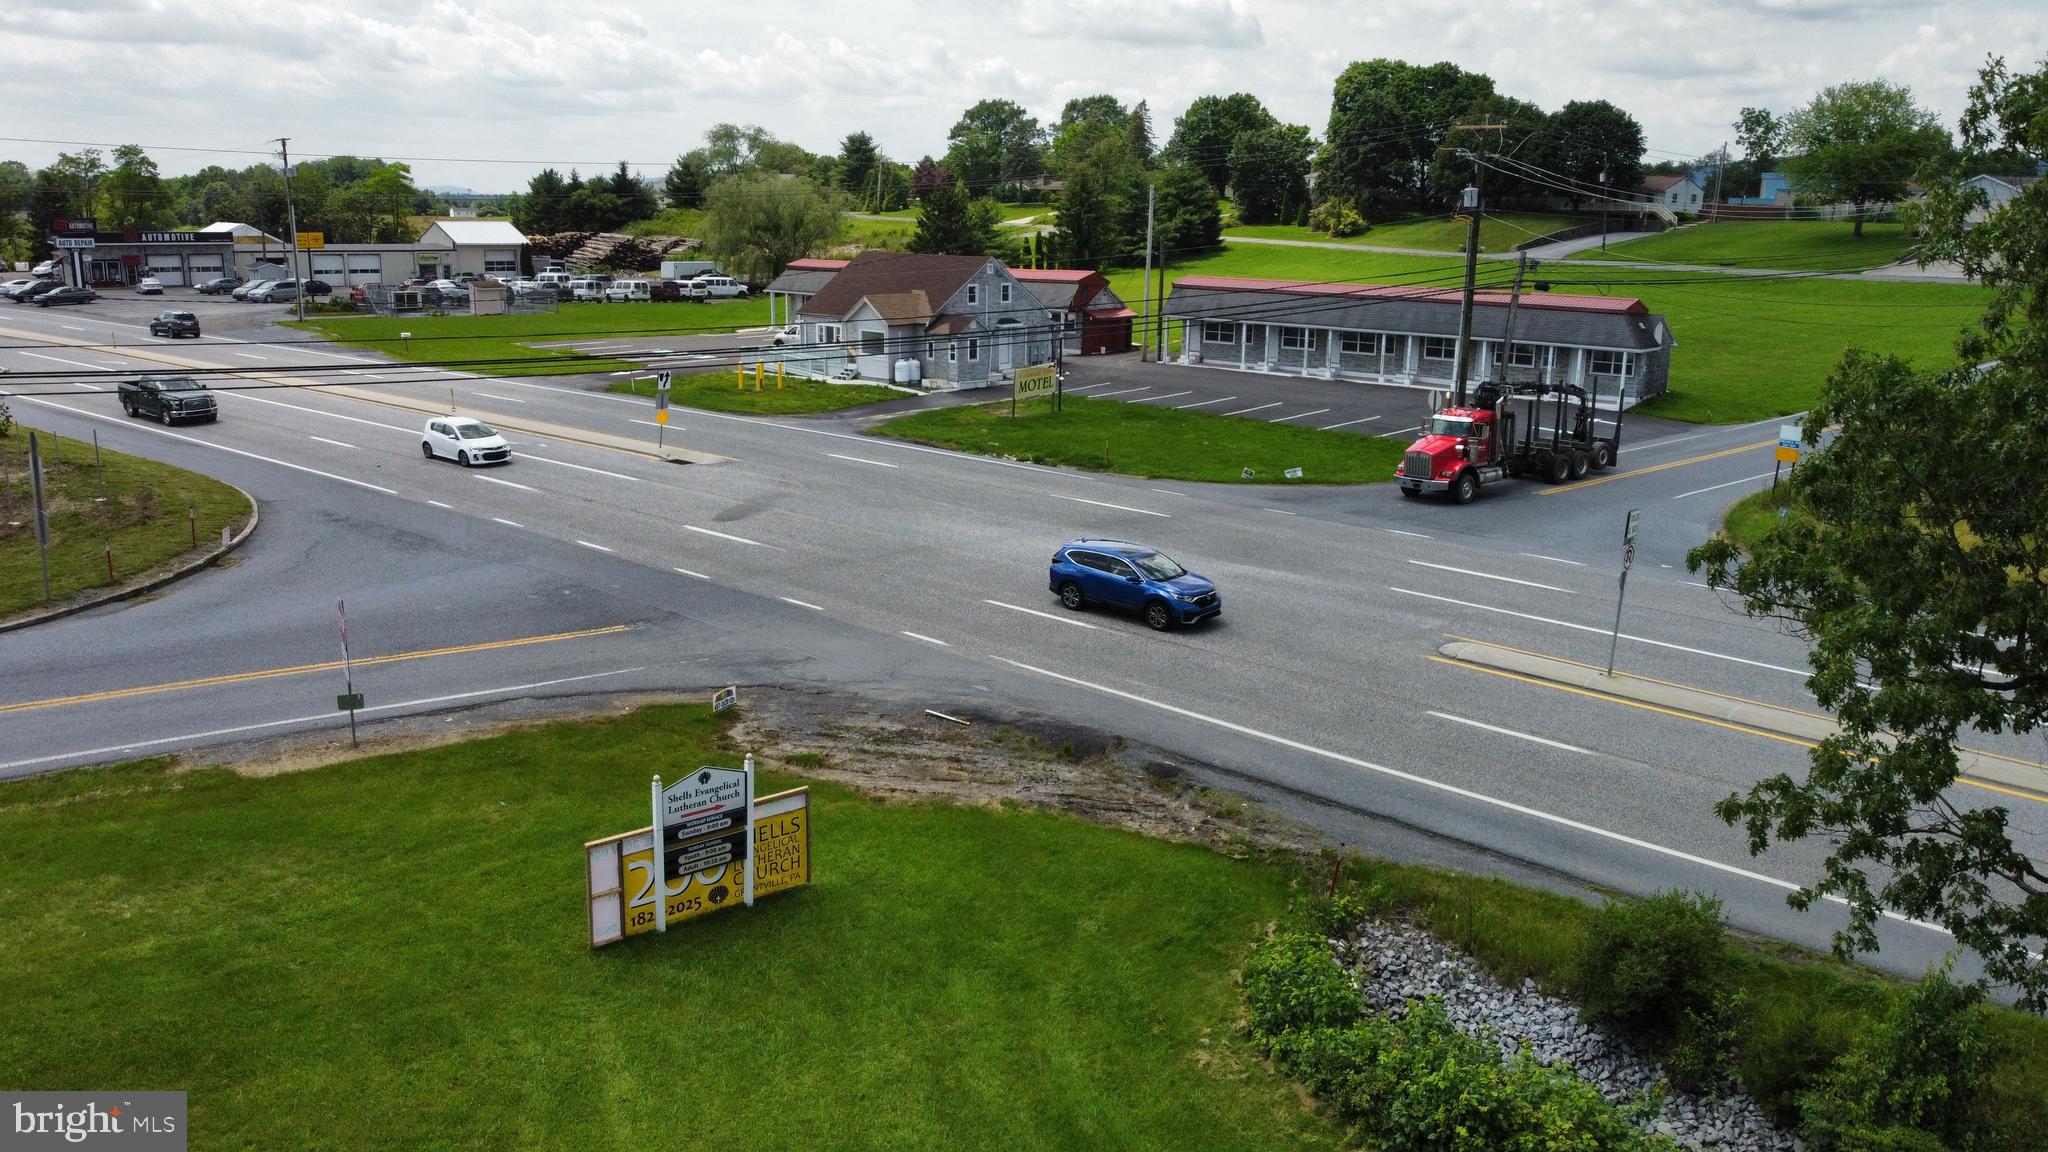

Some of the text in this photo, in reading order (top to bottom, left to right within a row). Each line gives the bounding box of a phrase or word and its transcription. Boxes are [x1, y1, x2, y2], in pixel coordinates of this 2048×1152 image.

[58, 239, 93, 247] AUTO REPAIR
[141, 233, 195, 242] AUTOMOTIVE
[1018, 376, 1054, 393] MOTEL
[667, 778, 740, 804] Shells Evangelical
[668, 789, 740, 815] Lutheran Church
[681, 827, 703, 837] Sunday
[706, 822, 719, 830] 9:00
[753, 816, 801, 844] ELLS
[684, 851, 701, 861] Youth
[704, 847, 717, 855] 9:00
[753, 834, 799, 854] NGELICAL
[683, 863, 699, 872] Adult
[733, 842, 800, 873] LUHERAN
[733, 855, 801, 886] CURCH
[734, 872, 801, 898] GRNTVILLE, PA
[630, 896, 702, 928] 182-2025
